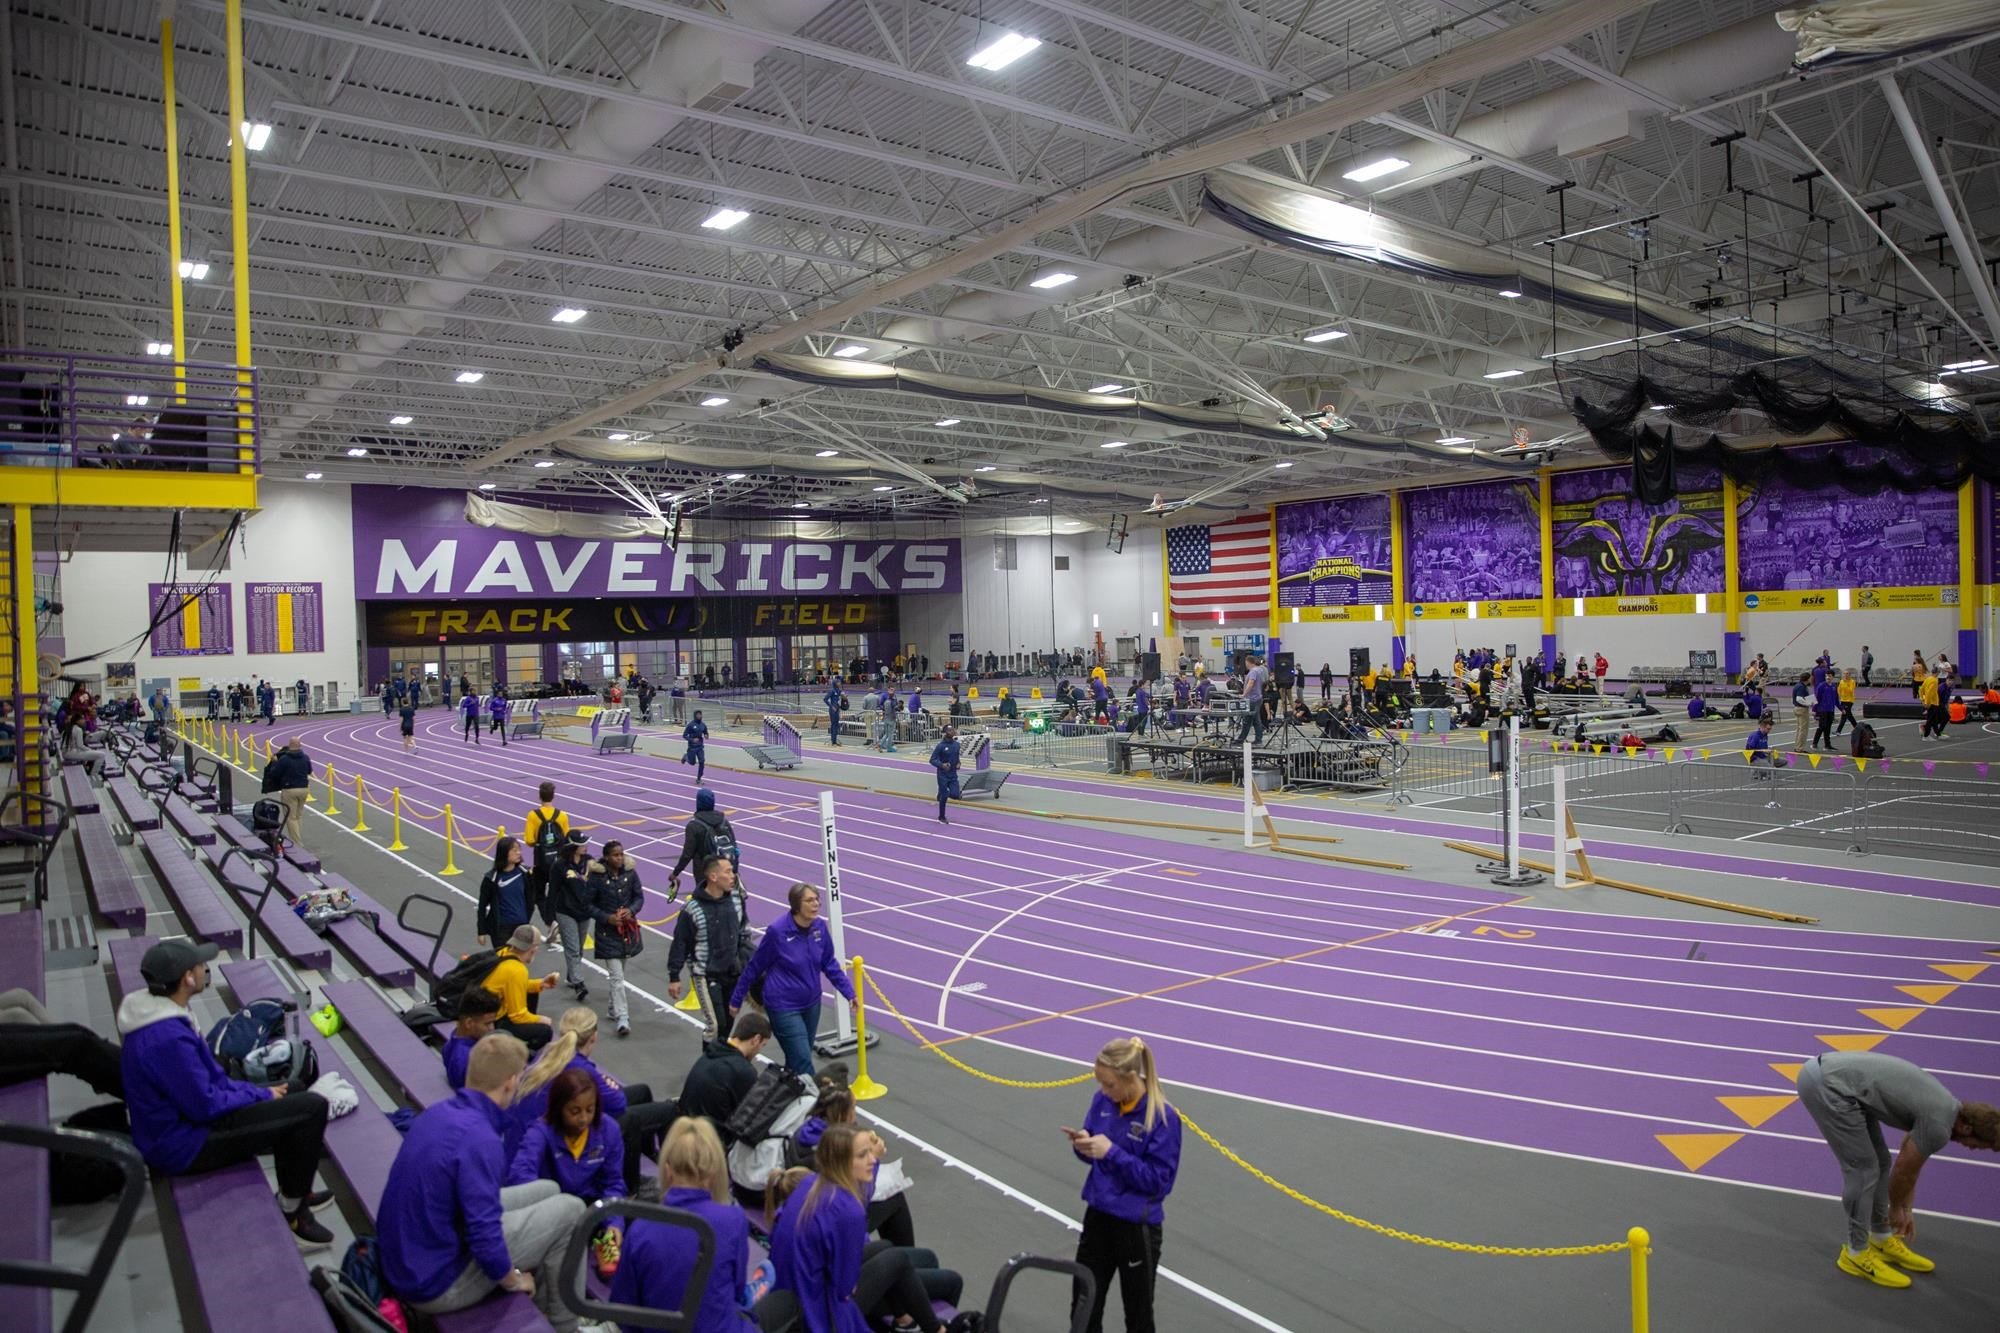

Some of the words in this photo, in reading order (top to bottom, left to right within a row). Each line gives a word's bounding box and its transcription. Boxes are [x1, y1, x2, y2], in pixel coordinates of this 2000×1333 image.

[375, 539, 949, 594] MAVERICKS
[1311, 565, 1361, 581] CHAMPIONS
[1317, 558, 1353, 566] NATIONAL
[254, 586, 285, 594] OUTDOOR
[286, 586, 314, 594] RECORDS
[411, 608, 572, 635] TRACK
[755, 604, 867, 626] FIELD
[826, 825, 839, 902] FINISH
